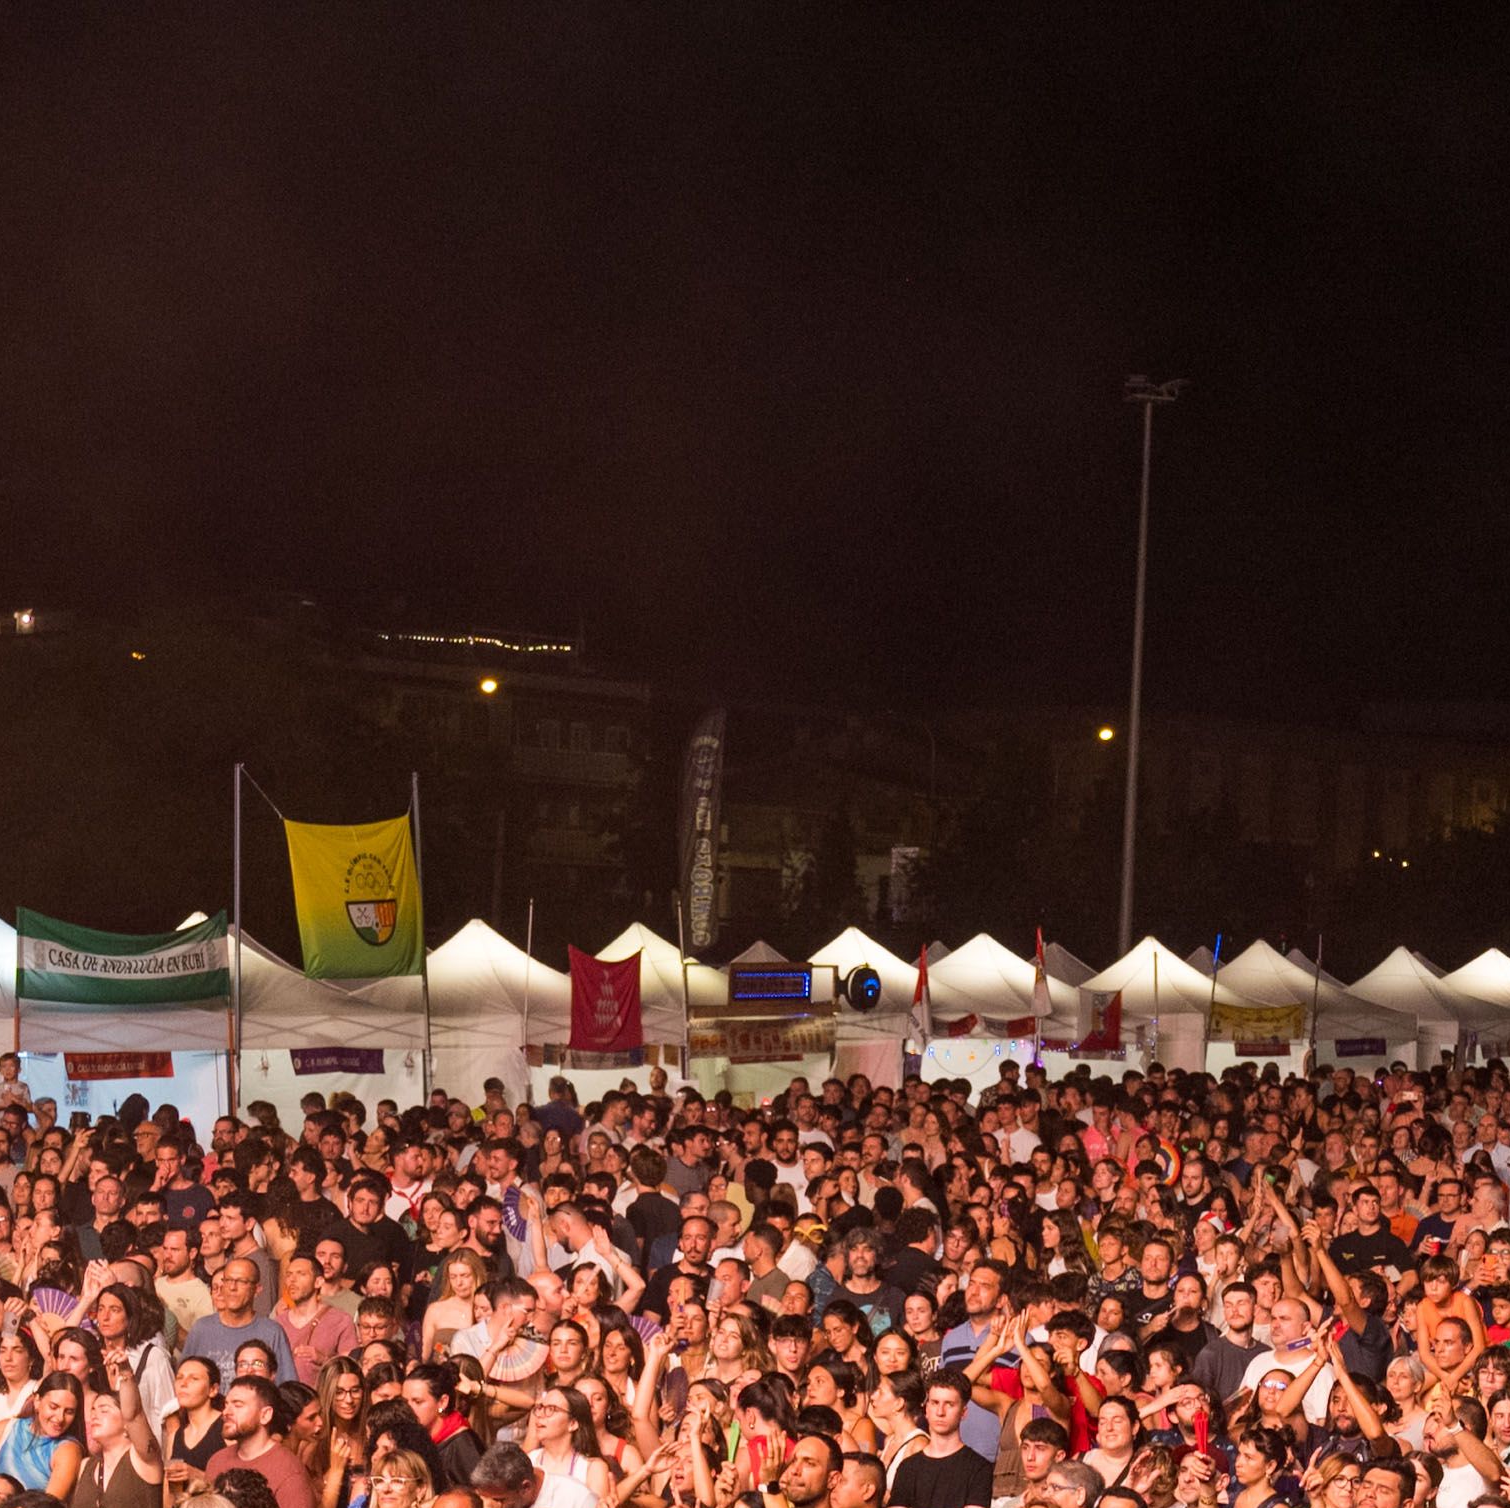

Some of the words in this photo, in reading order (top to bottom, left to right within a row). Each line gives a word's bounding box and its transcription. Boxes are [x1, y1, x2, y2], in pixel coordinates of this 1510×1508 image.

[48, 948, 80, 970] CASA
[83, 955, 99, 971] DE
[167, 956, 181, 973] EN
[182, 949, 206, 970] RUBÍ
